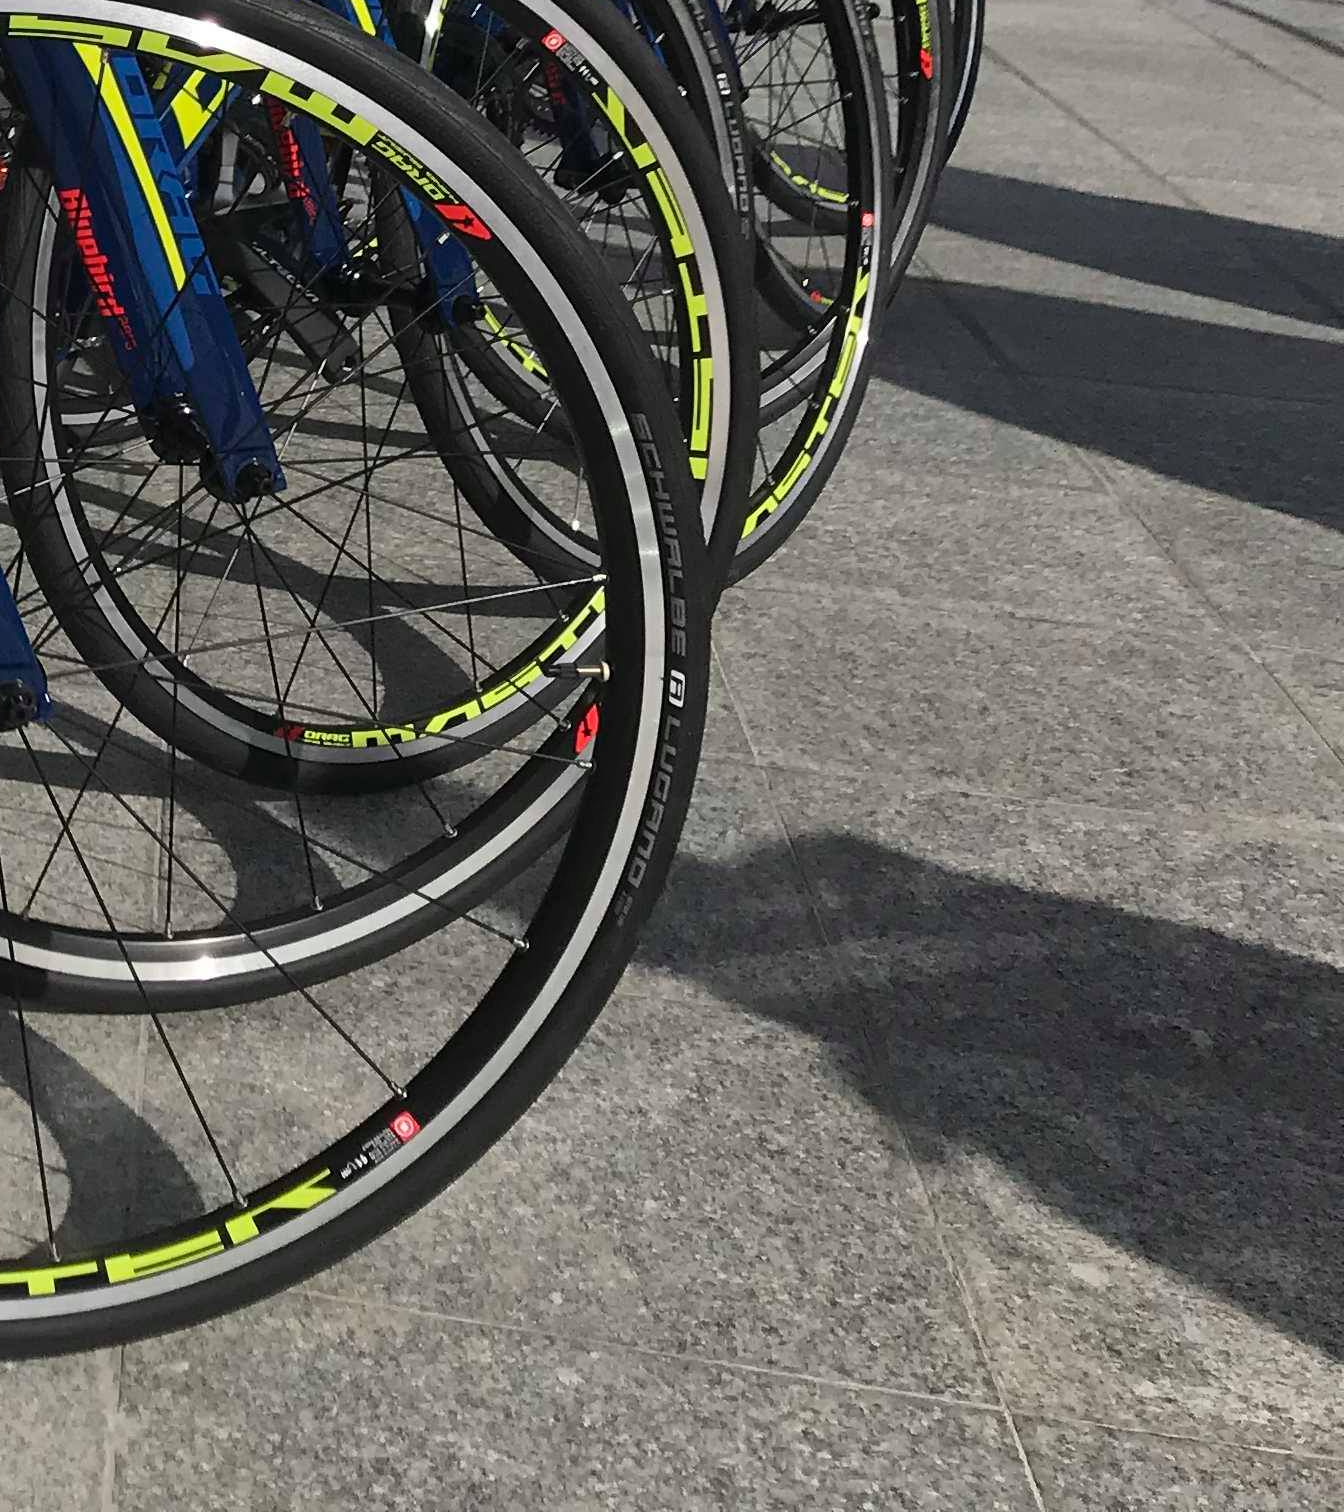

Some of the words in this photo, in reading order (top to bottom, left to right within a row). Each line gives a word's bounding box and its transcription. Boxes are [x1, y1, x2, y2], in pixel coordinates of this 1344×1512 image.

[371, 139, 446, 202] DRAG
[631, 411, 689, 658] SCHWALBE
[303, 729, 352, 744] DRAG
[626, 716, 684, 891] LUGANO
